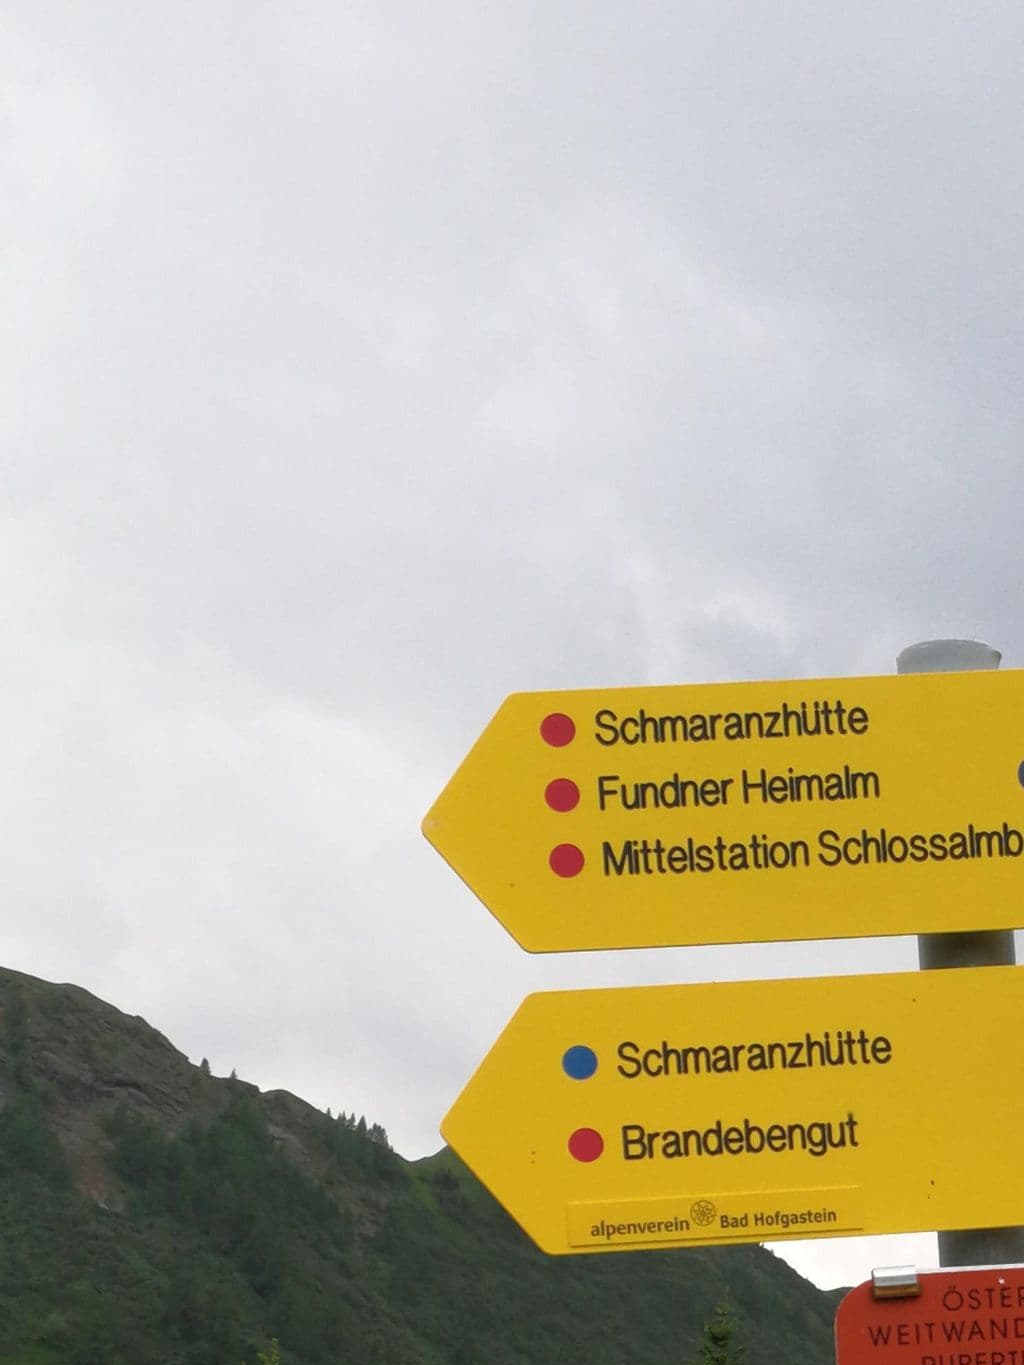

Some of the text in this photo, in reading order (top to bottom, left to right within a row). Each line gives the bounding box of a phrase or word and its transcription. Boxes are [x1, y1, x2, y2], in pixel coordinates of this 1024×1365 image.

[594, 702, 869, 746] Schmaranzhütte
[597, 765, 880, 811] Fundner Heimalm
[602, 833, 810, 877] Mittelstation
[617, 1029, 892, 1079] Schmaranzhütte
[621, 1112, 859, 1161] Brandebengut
[590, 1209, 837, 1240] alpenverein Bad Hofgastein
